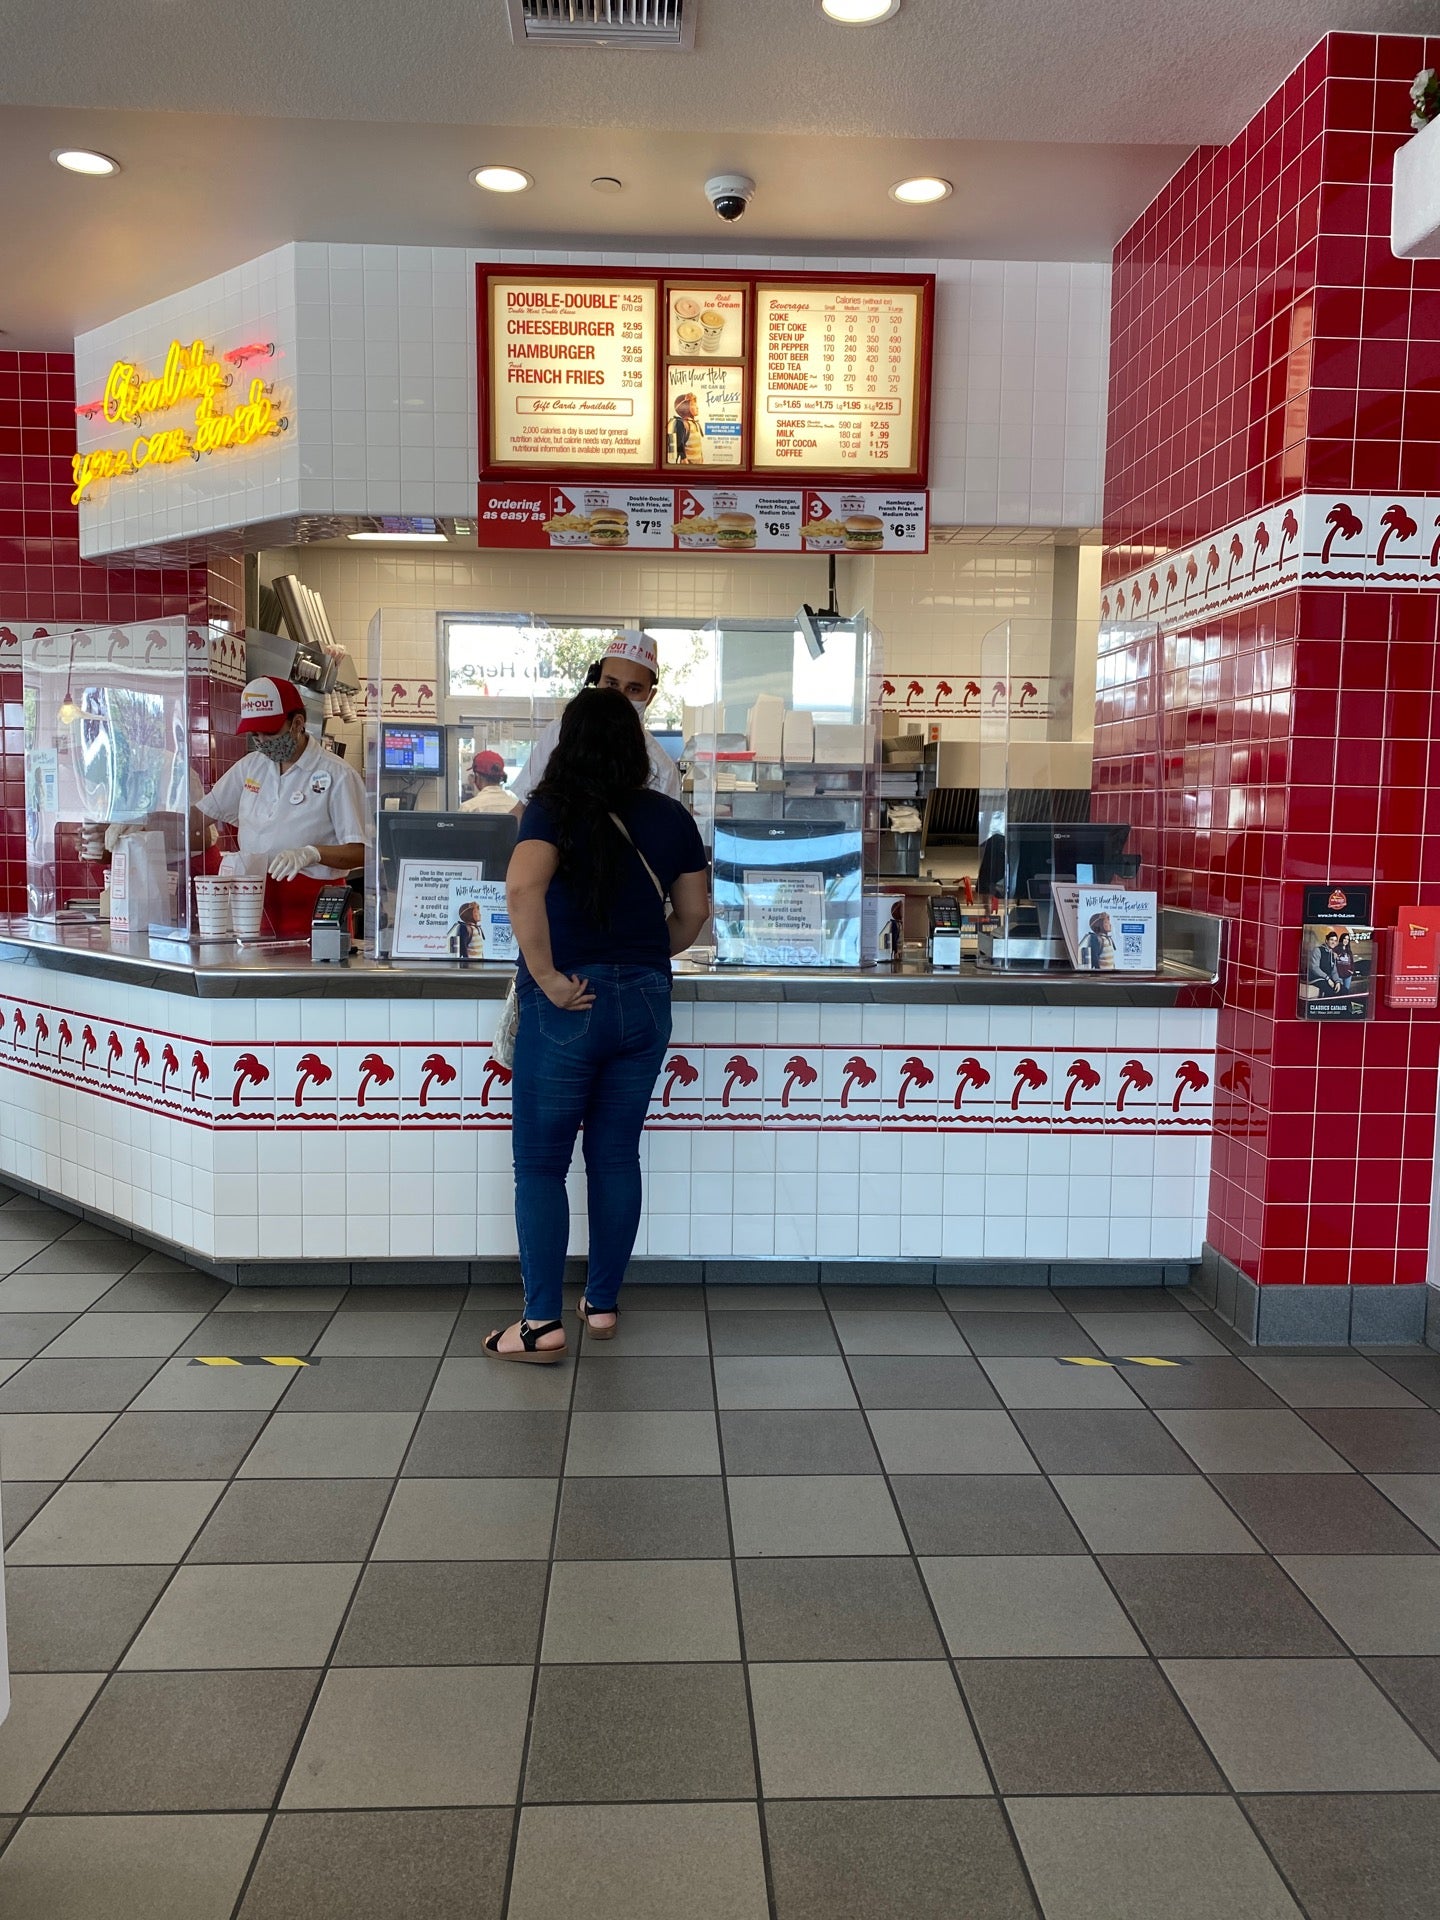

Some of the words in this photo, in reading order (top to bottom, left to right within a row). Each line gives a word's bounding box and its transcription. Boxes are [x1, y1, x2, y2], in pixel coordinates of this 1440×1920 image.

[507, 292, 618, 309] DOUBLE-DOUBLE
[623, 295, 643, 303] $4.25
[769, 299, 810, 312] Beverages
[835, 296, 861, 305] Calories
[621, 304, 633, 312] 670
[634, 304, 643, 312] cal
[769, 313, 789, 321] COKE
[507, 320, 615, 337] CHEESEBURGER
[623, 322, 643, 331] $2.95
[769, 323, 785, 331] DIET
[787, 323, 807, 331] COKE
[634, 331, 643, 339] cal
[769, 333, 792, 341] SEVEN
[507, 344, 595, 360] HAMBURGER
[623, 346, 643, 354] $2.65
[769, 343, 779, 351] DR
[781, 343, 809, 351] PEPPER
[634, 355, 643, 363] cal
[790, 353, 809, 361] BEER
[507, 368, 562, 384] FRENCH
[566, 370, 605, 385] FRIES
[669, 368, 687, 386] With
[688, 368, 706, 387] Your
[706, 367, 727, 384] Help
[634, 380, 643, 388] cal
[706, 390, 741, 407] Fearless
[532, 400, 550, 411] Gift
[552, 400, 576, 410] Cards
[578, 401, 617, 411] Available
[776, 420, 806, 428] SHAKES
[852, 421, 861, 429] cal
[870, 422, 889, 430] $2.55
[852, 431, 861, 439] cal
[776, 439, 790, 447] HOT
[792, 440, 817, 448] COCOA
[776, 449, 802, 457] COFFEE
[847, 450, 857, 458] cal
[71, 449, 132, 506] you
[488, 498, 542, 512] Ordering
[553, 495, 567, 513] 1
[682, 498, 696, 516] 2
[809, 500, 823, 518] 3
[482, 512, 498, 520] as
[500, 512, 529, 523] easy
[530, 512, 546, 521] as
